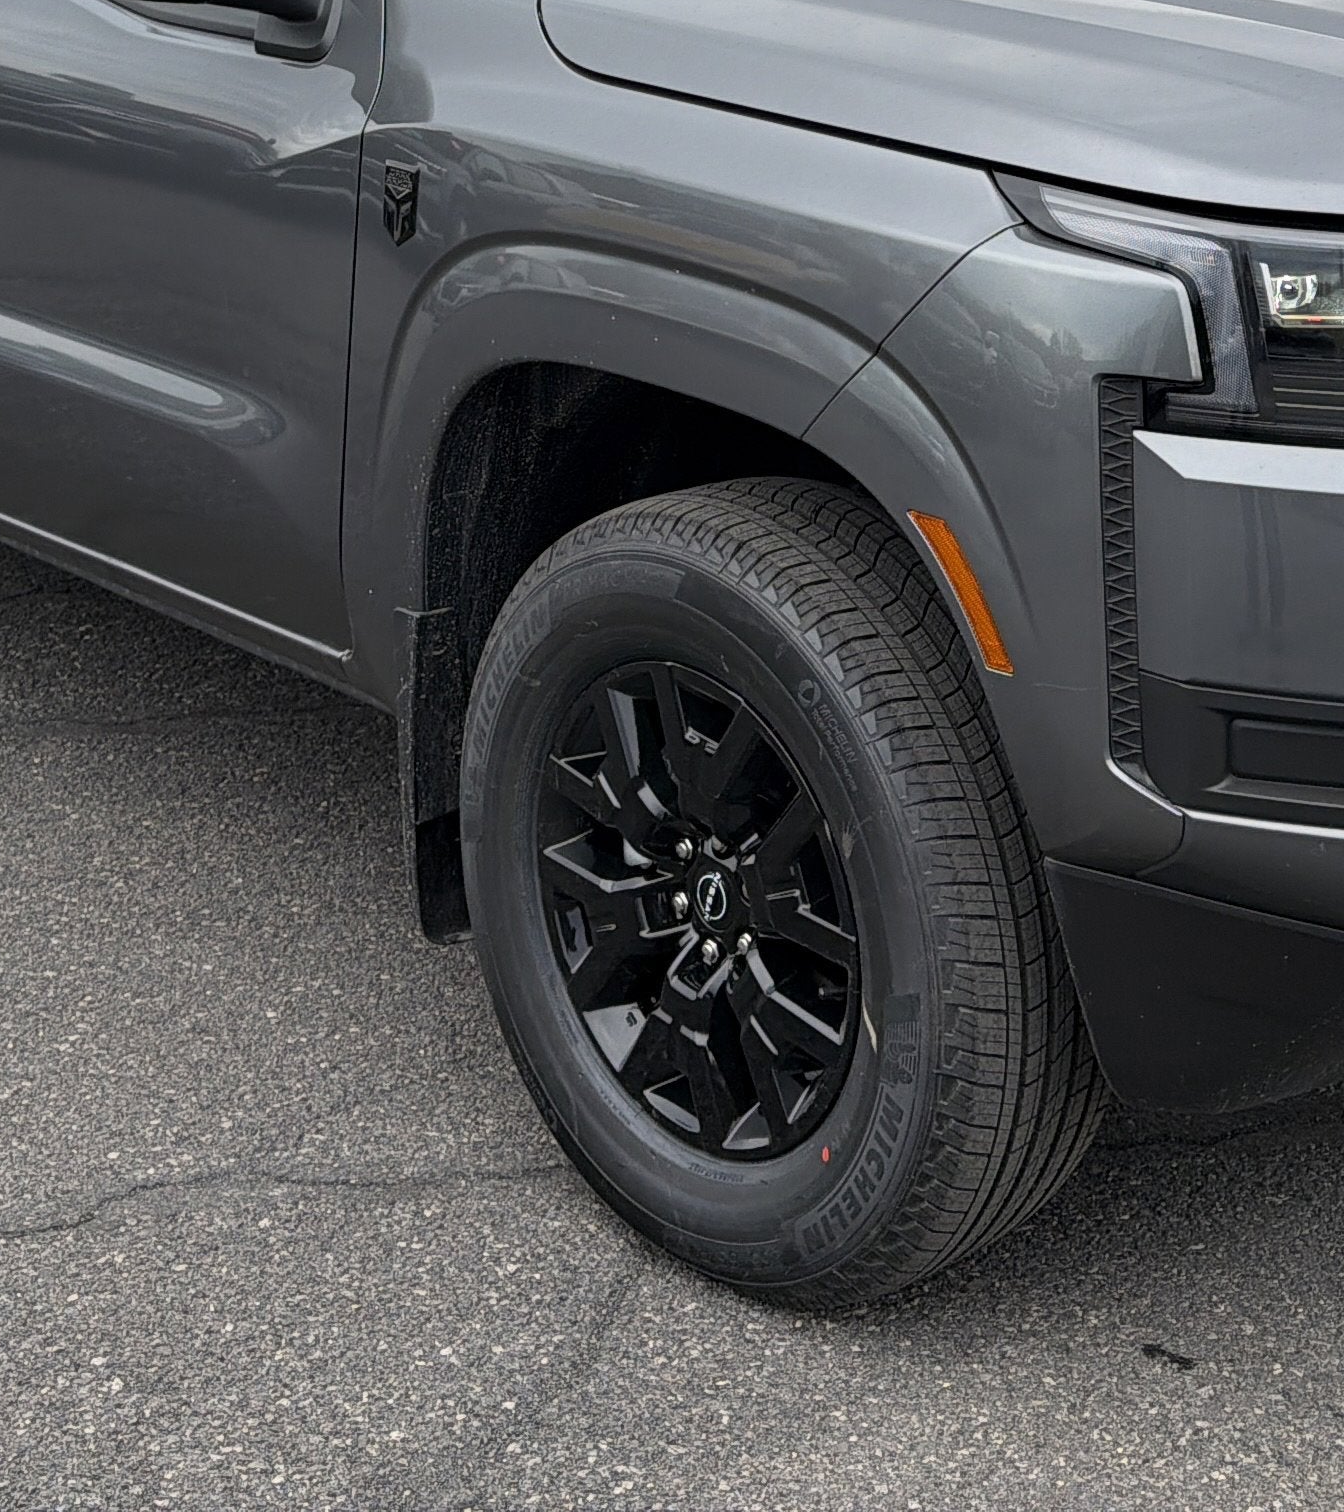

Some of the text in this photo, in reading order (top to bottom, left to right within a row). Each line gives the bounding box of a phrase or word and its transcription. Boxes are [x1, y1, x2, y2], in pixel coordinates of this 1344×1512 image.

[472, 600, 550, 756] MICHELIN
[817, 703, 858, 763] MICHELIN
[802, 1093, 904, 1255] MICHELIN
